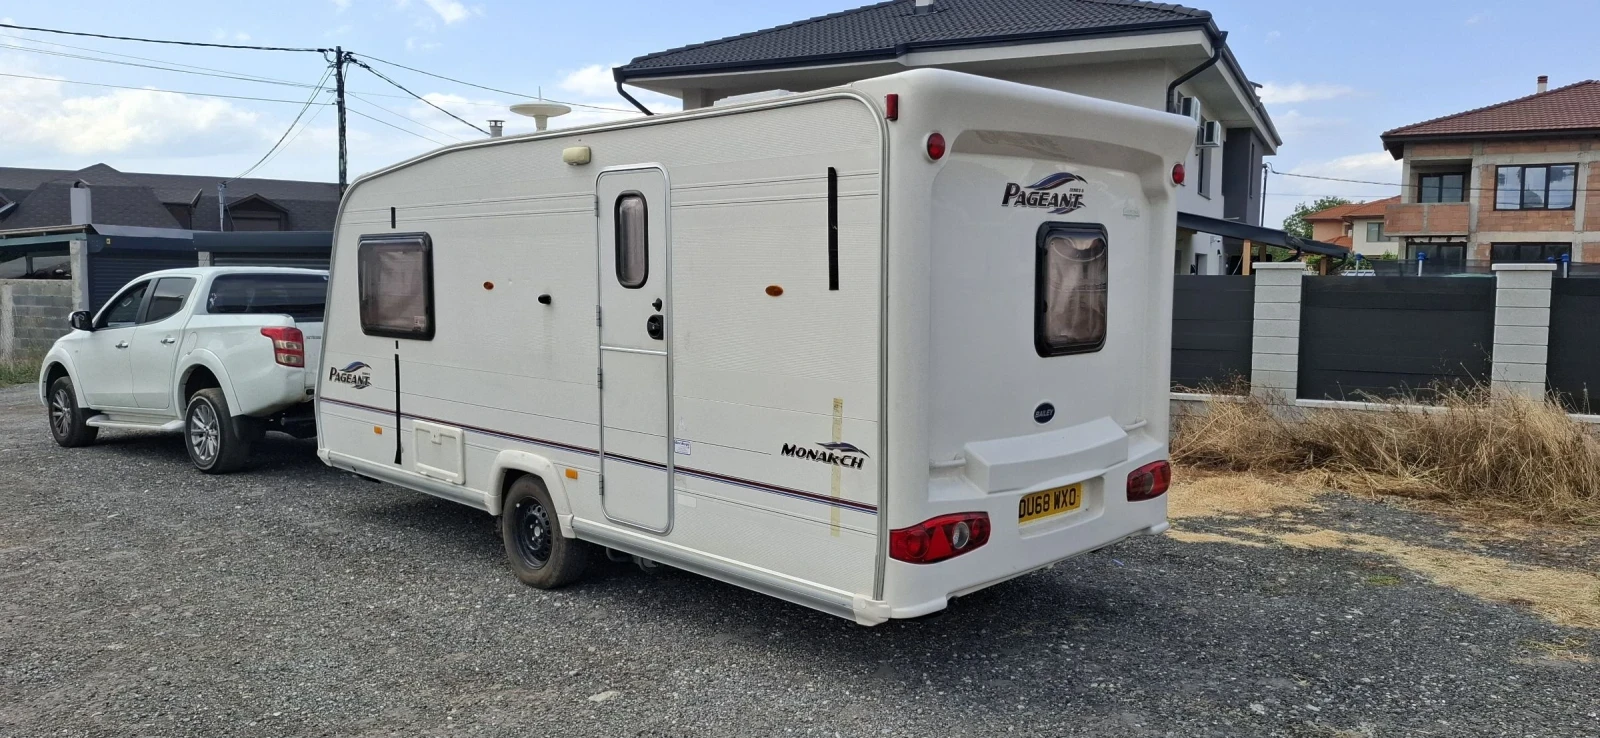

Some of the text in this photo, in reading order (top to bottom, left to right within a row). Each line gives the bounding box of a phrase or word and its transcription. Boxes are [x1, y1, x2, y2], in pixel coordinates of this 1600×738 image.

[1001, 183, 1083, 208] PAGEANT
[329, 367, 370, 386] PAGEANT
[781, 443, 864, 470] MONARCH
